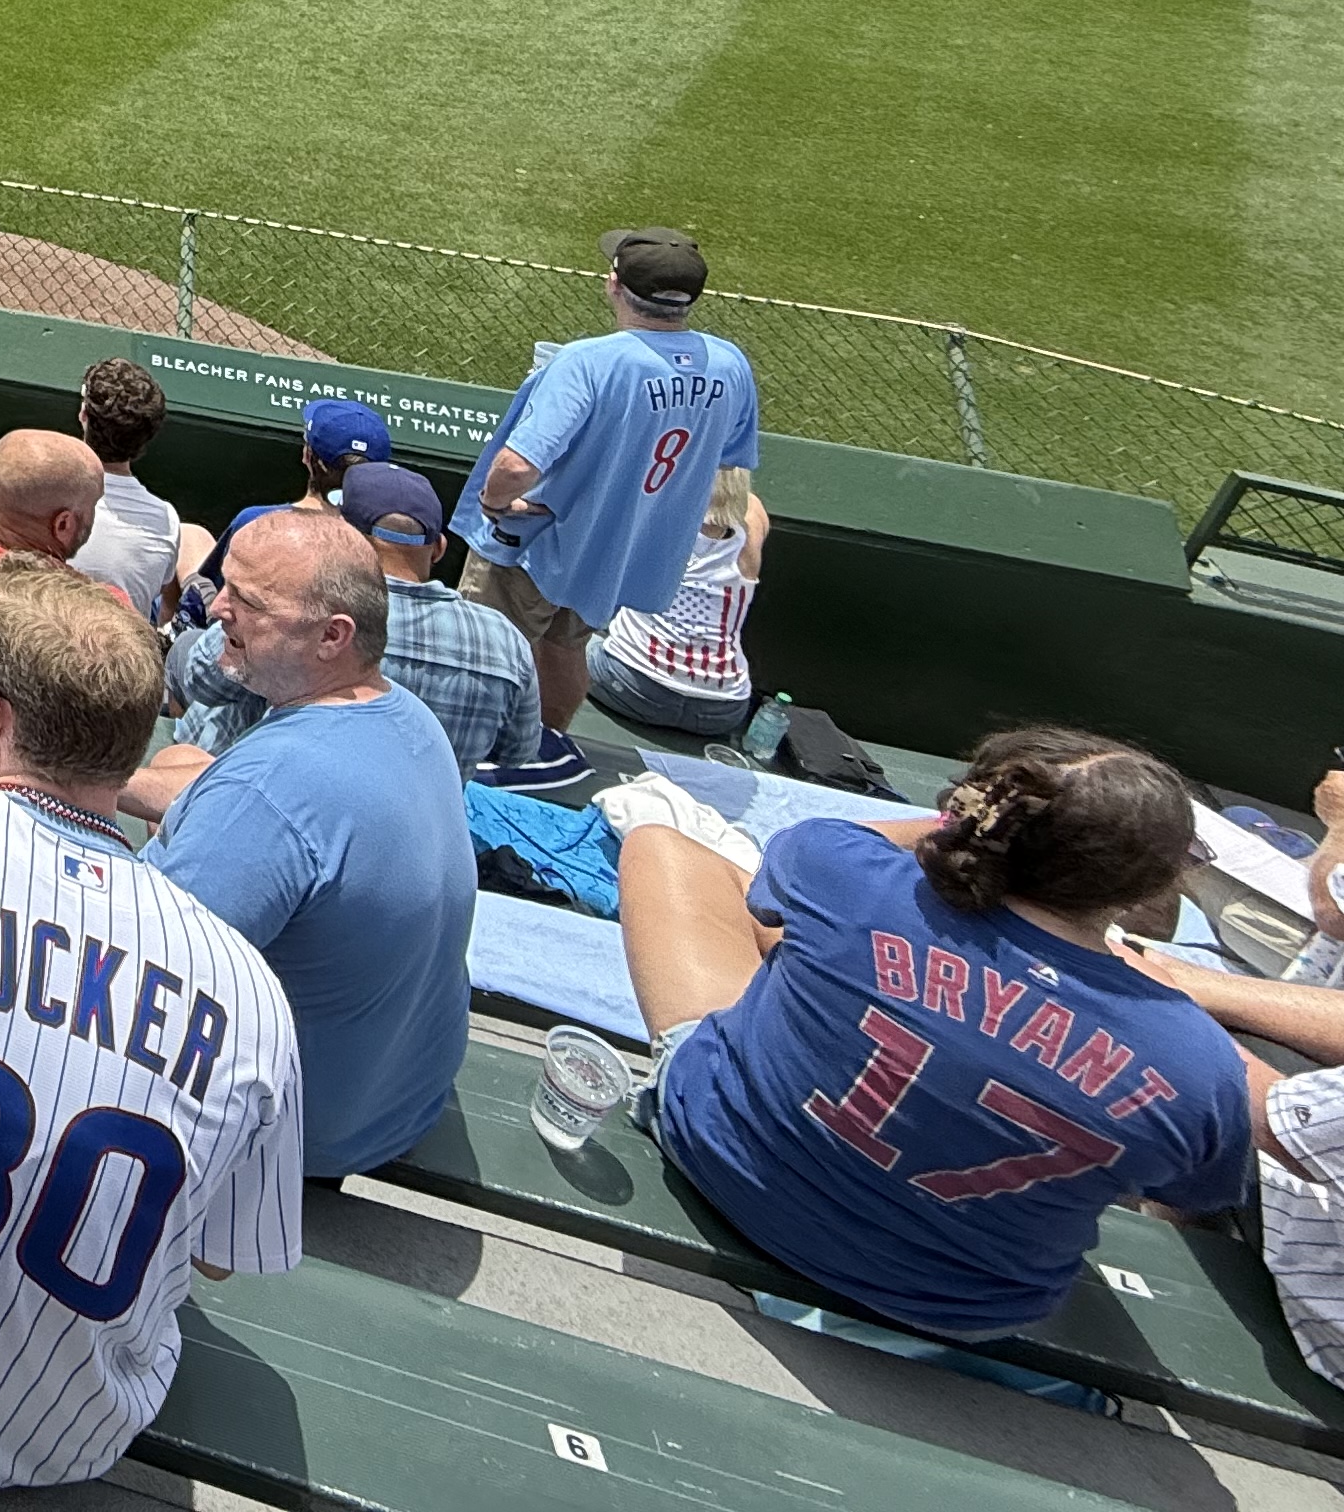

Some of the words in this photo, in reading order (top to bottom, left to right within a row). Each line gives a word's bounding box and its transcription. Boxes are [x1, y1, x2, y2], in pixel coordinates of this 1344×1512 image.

[151, 354, 249, 383] BLEACHER
[255, 372, 304, 393] FANS
[310, 382, 349, 400] ARE
[353, 389, 393, 408] THE
[398, 397, 501, 426] GREATEST
[270, 394, 312, 411] LET'
[386, 414, 403, 429] IT
[411, 417, 461, 439] THAT
[646, 375, 725, 411] HAPP
[643, 428, 690, 494] 8
[870, 929, 1179, 1122] BRYANT
[802, 1004, 1126, 1205] 17
